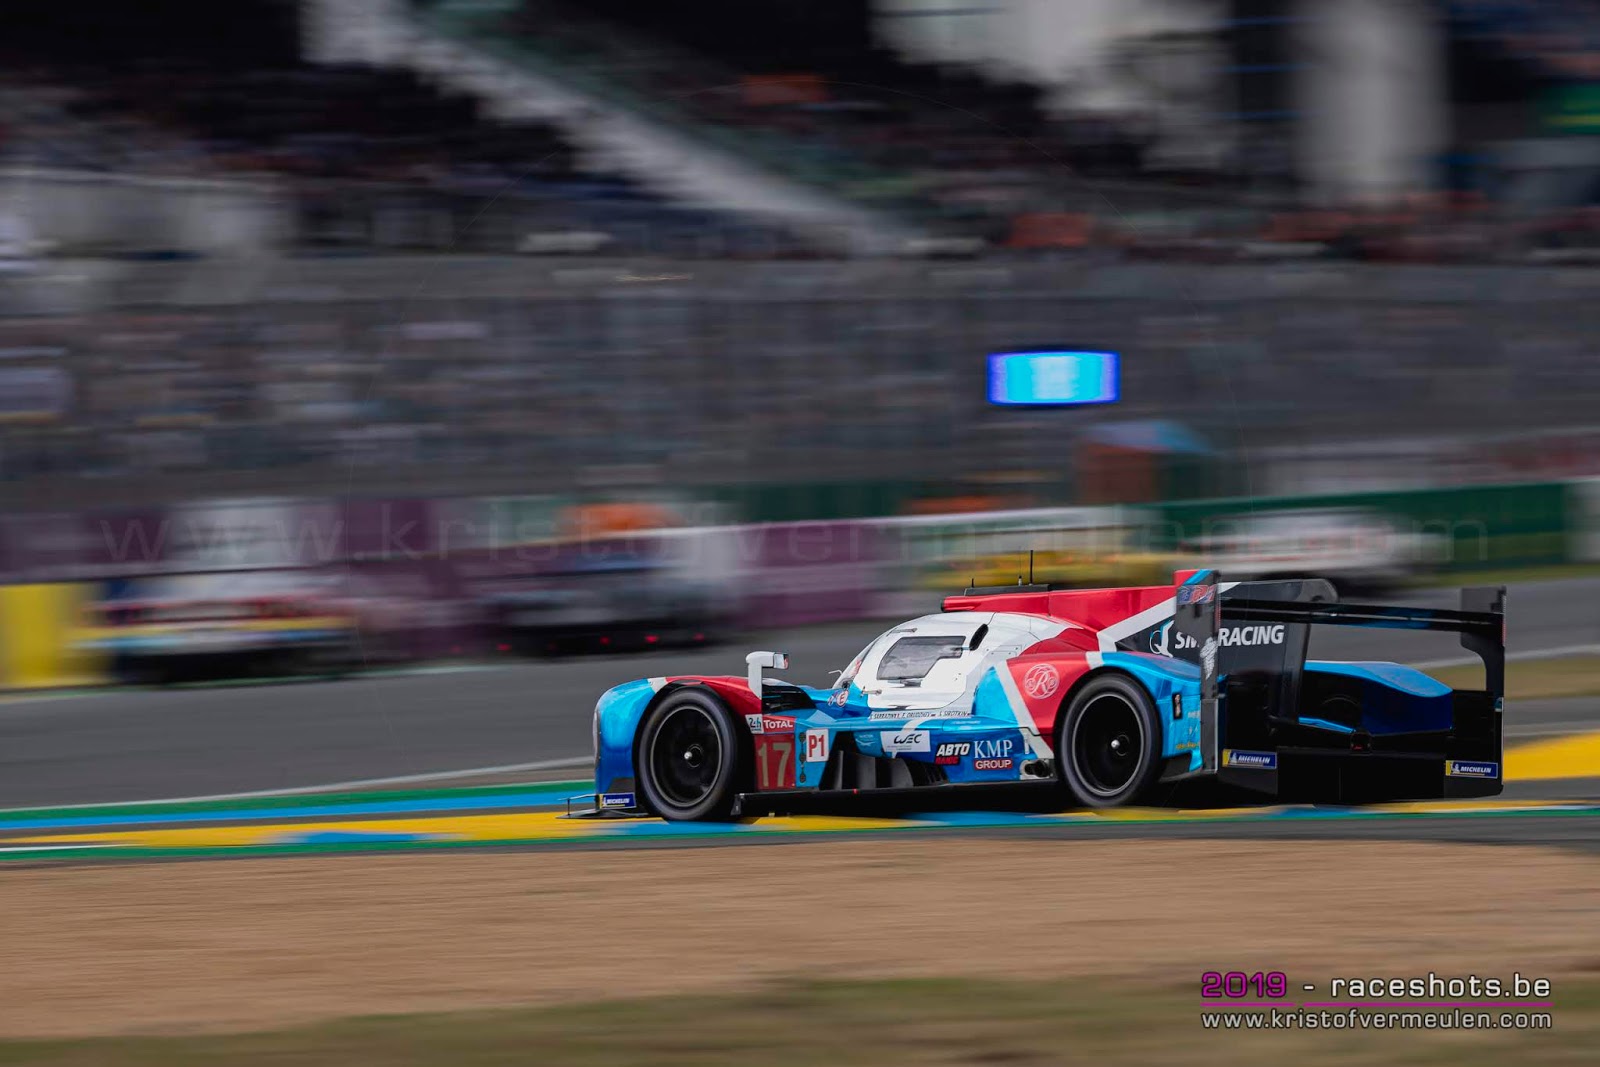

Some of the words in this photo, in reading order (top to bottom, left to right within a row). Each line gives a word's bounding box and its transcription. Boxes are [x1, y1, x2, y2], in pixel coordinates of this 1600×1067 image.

[1218, 625, 1285, 647] RACING
[763, 719, 794, 729] TOTAL
[893, 733, 923, 744] WEC
[808, 734, 825, 758] P1
[973, 739, 1014, 759] KMP
[758, 741, 792, 788] 17
[975, 759, 1012, 770] GROUP
[1238, 754, 1271, 764] MICHELIN
[1460, 766, 1492, 774] MICHELIN
